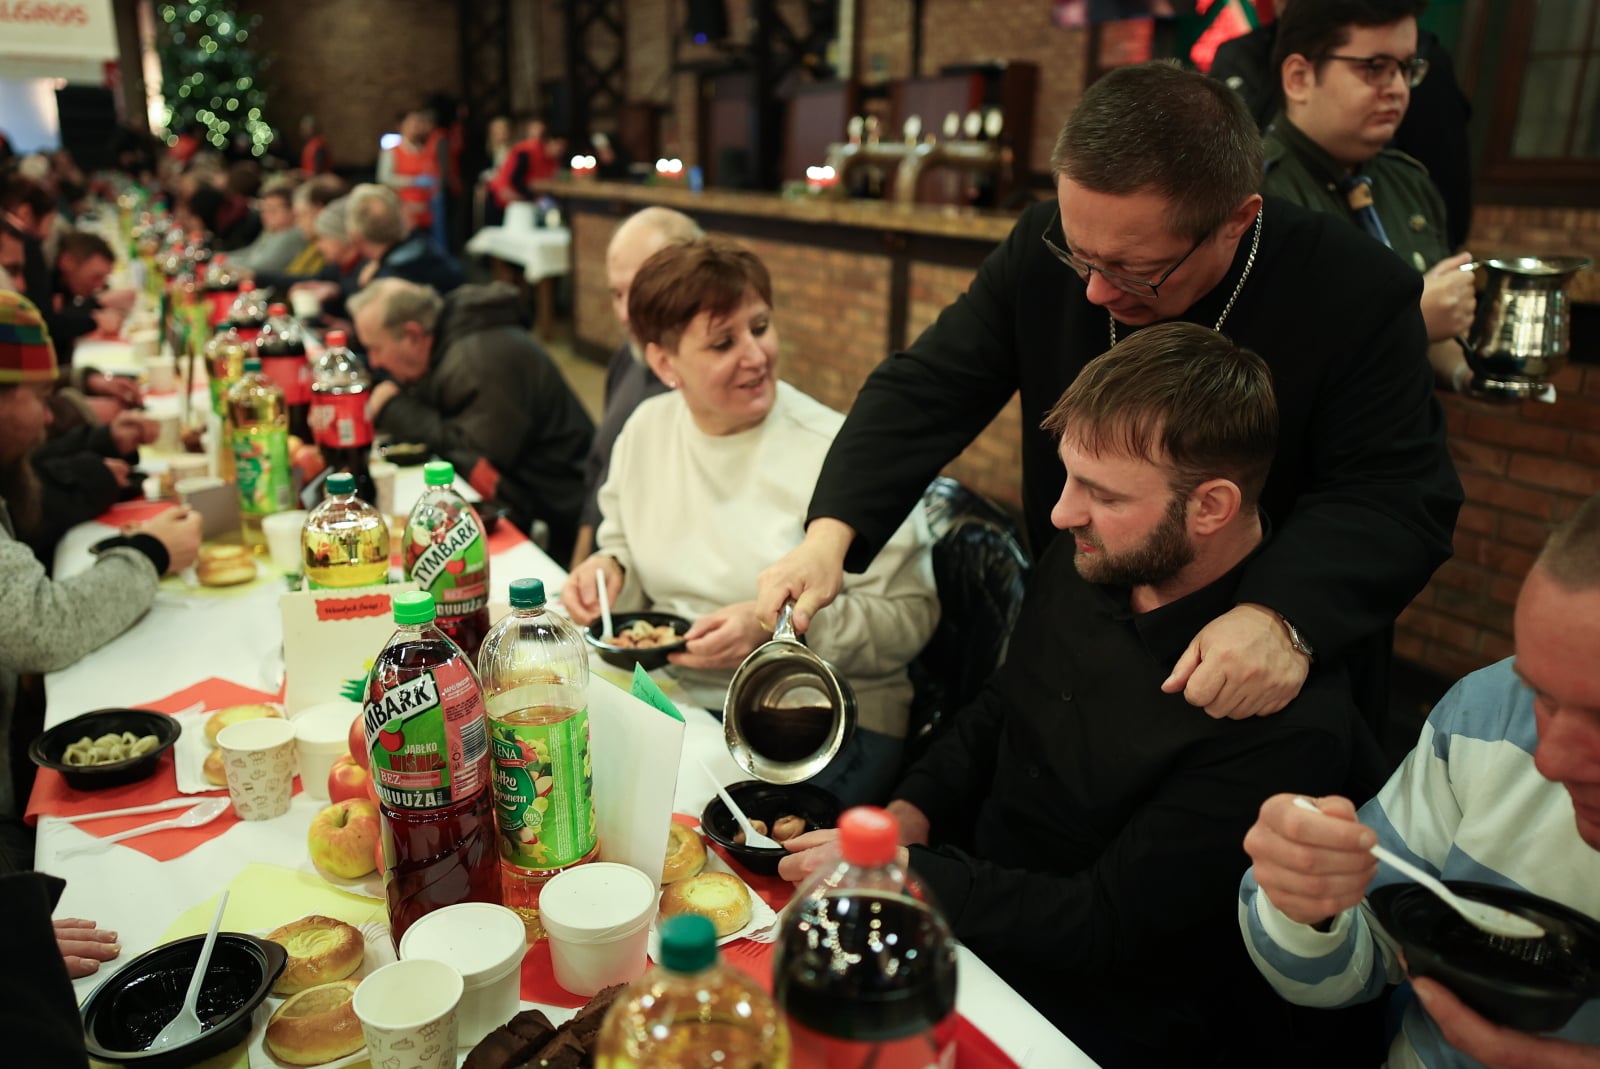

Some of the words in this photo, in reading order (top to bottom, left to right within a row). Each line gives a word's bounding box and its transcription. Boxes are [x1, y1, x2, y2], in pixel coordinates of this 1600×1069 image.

[414, 521, 477, 582] TYMBARK
[405, 743, 437, 754] JABŁKO
[380, 770, 401, 785] BEZ
